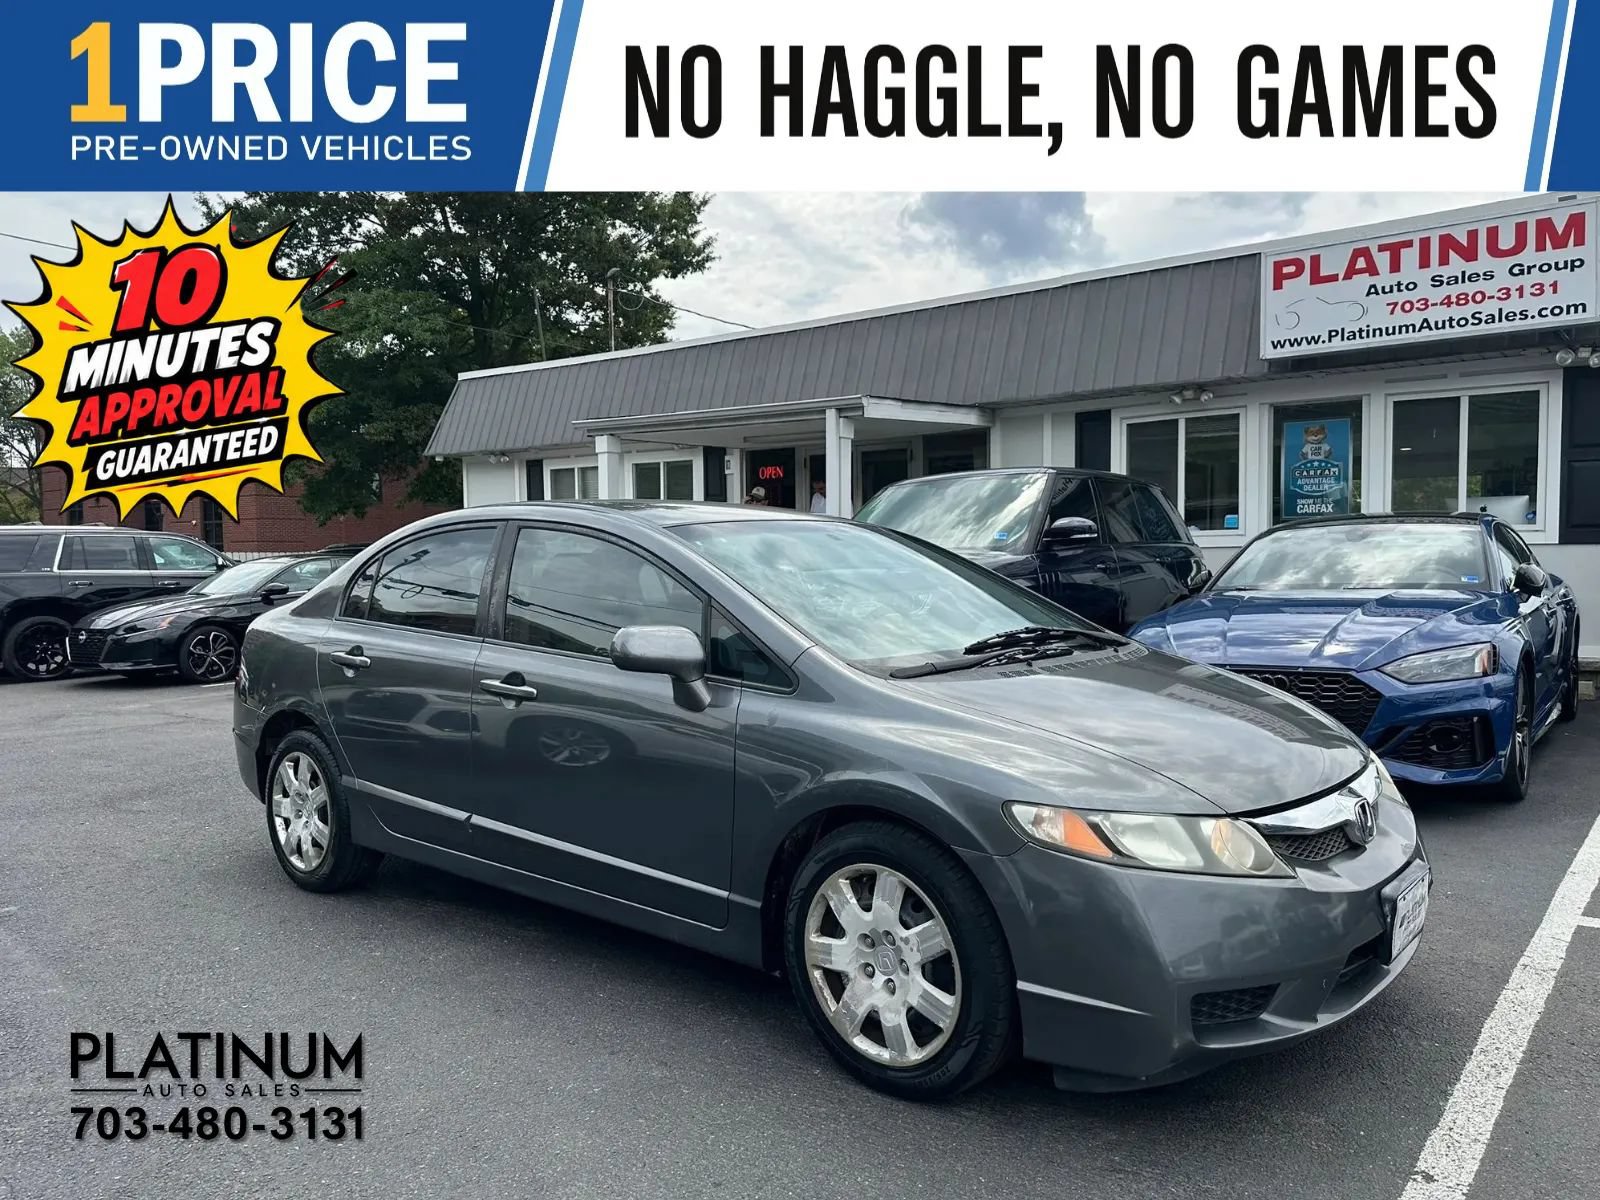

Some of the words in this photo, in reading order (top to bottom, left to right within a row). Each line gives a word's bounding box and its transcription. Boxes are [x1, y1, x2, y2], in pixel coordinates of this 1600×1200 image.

[1273, 211, 1586, 291] PLATINUM
[1365, 281, 1418, 297] Auto
[1430, 268, 1495, 288] Sales
[1508, 257, 1585, 277] Group
[1386, 280, 1559, 316] 703-480-3131
[1271, 301, 1587, 350] www.PlatinumAutoSales.com
[759, 466, 784, 479] OPEN
[1295, 468, 1339, 476] CARFAX
[1297, 477, 1336, 485] ADVANTAGE
[1297, 504, 1334, 513] CARFAX
